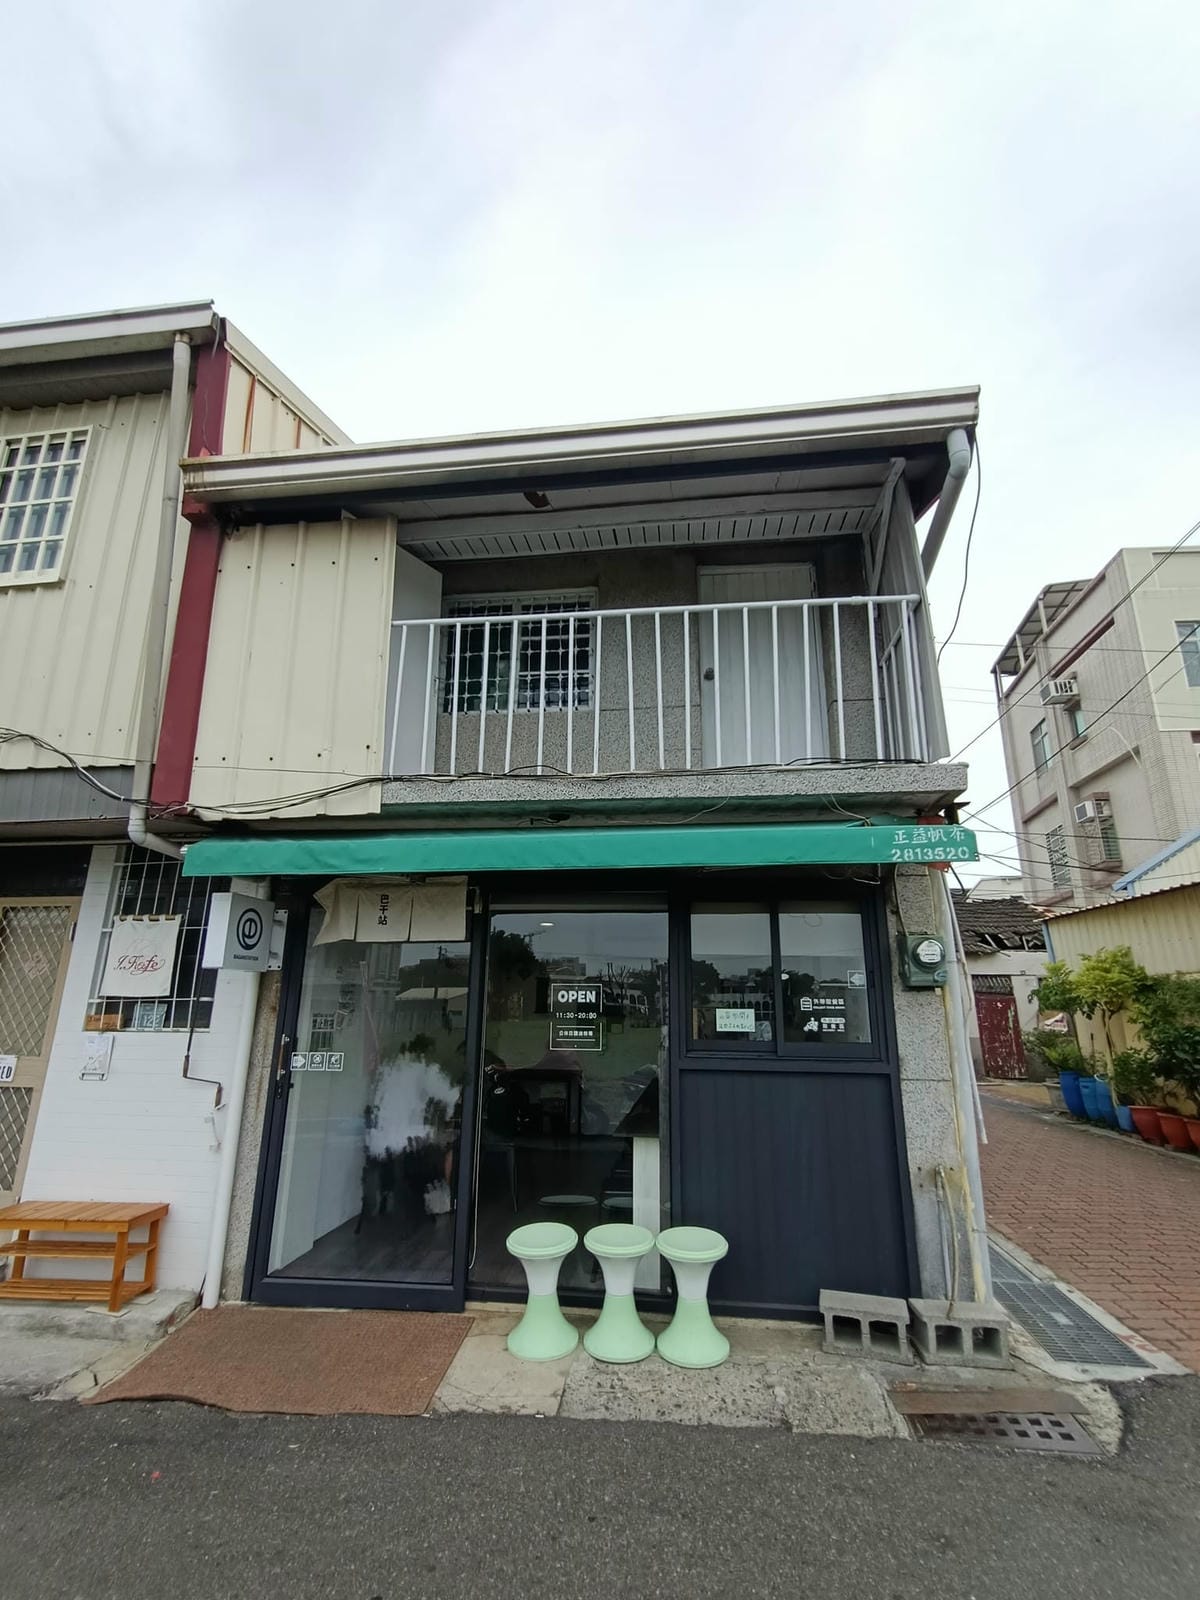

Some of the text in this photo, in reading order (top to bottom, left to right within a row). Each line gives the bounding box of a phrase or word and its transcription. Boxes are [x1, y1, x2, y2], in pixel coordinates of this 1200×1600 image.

[892, 827, 965, 844] 正益帆布
[891, 846, 969, 861] 2813520
[557, 990, 596, 1003] OPEN
[0, 1065, 13, 1080] ED
